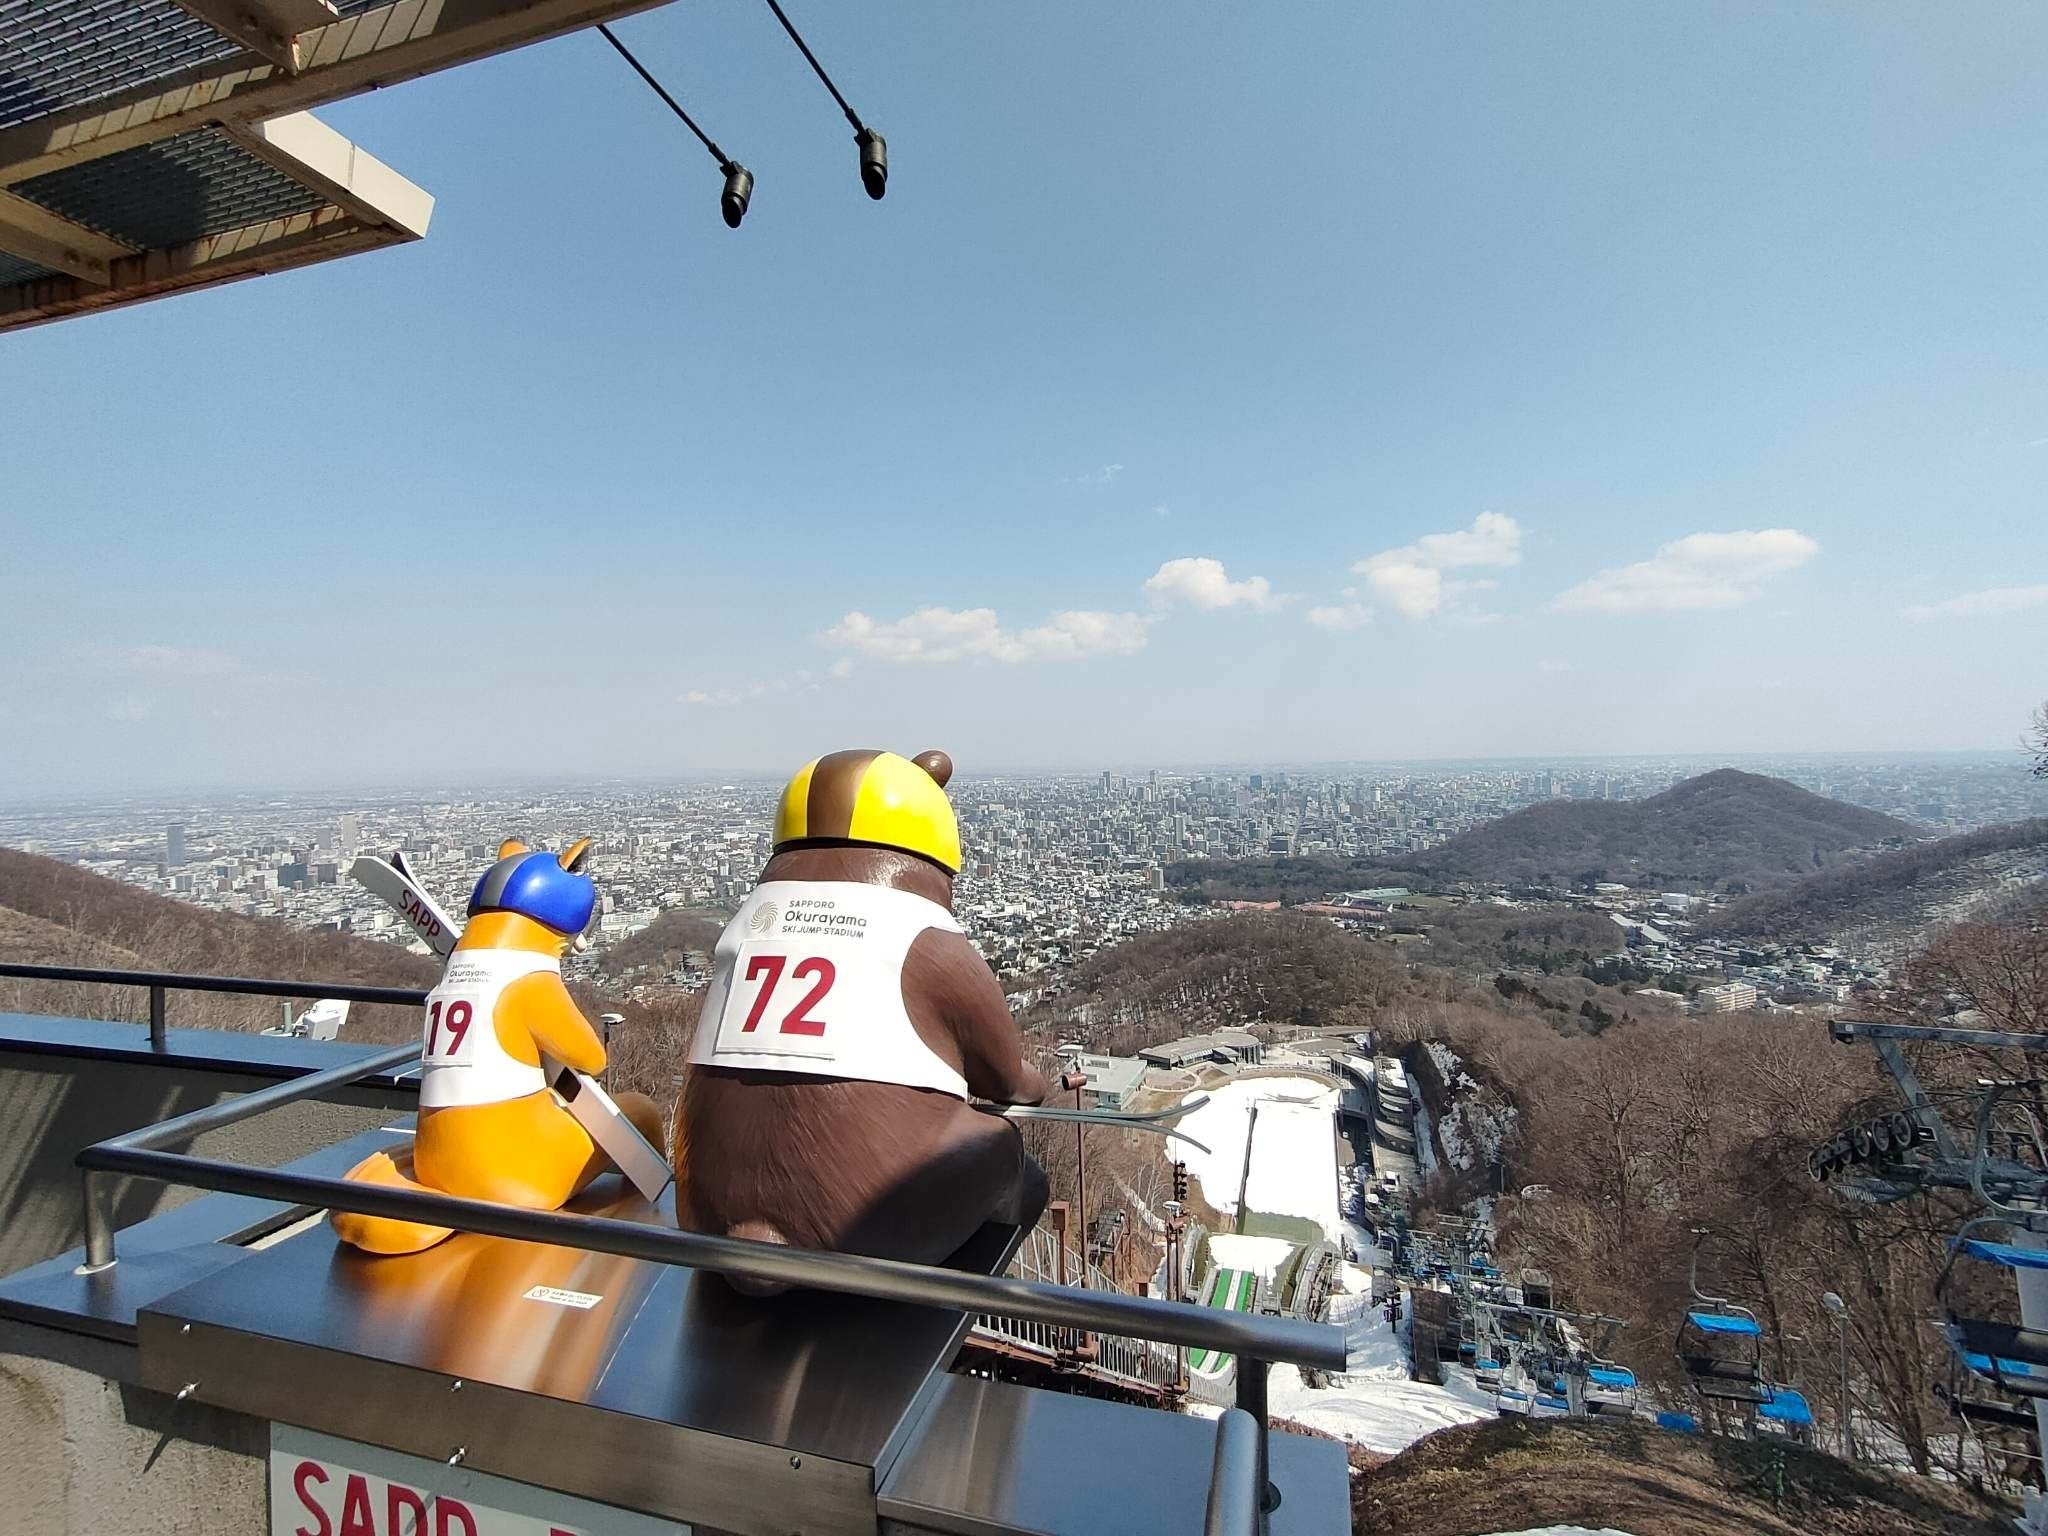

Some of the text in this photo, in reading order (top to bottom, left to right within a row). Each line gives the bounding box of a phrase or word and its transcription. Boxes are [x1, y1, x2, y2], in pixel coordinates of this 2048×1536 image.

[788, 899, 836, 909] SAPPORO
[784, 910, 867, 927] Okurayama
[781, 925, 864, 938] SKI JUMP STADIUM
[741, 955, 836, 1037] 72
[428, 1000, 473, 1056] 19
